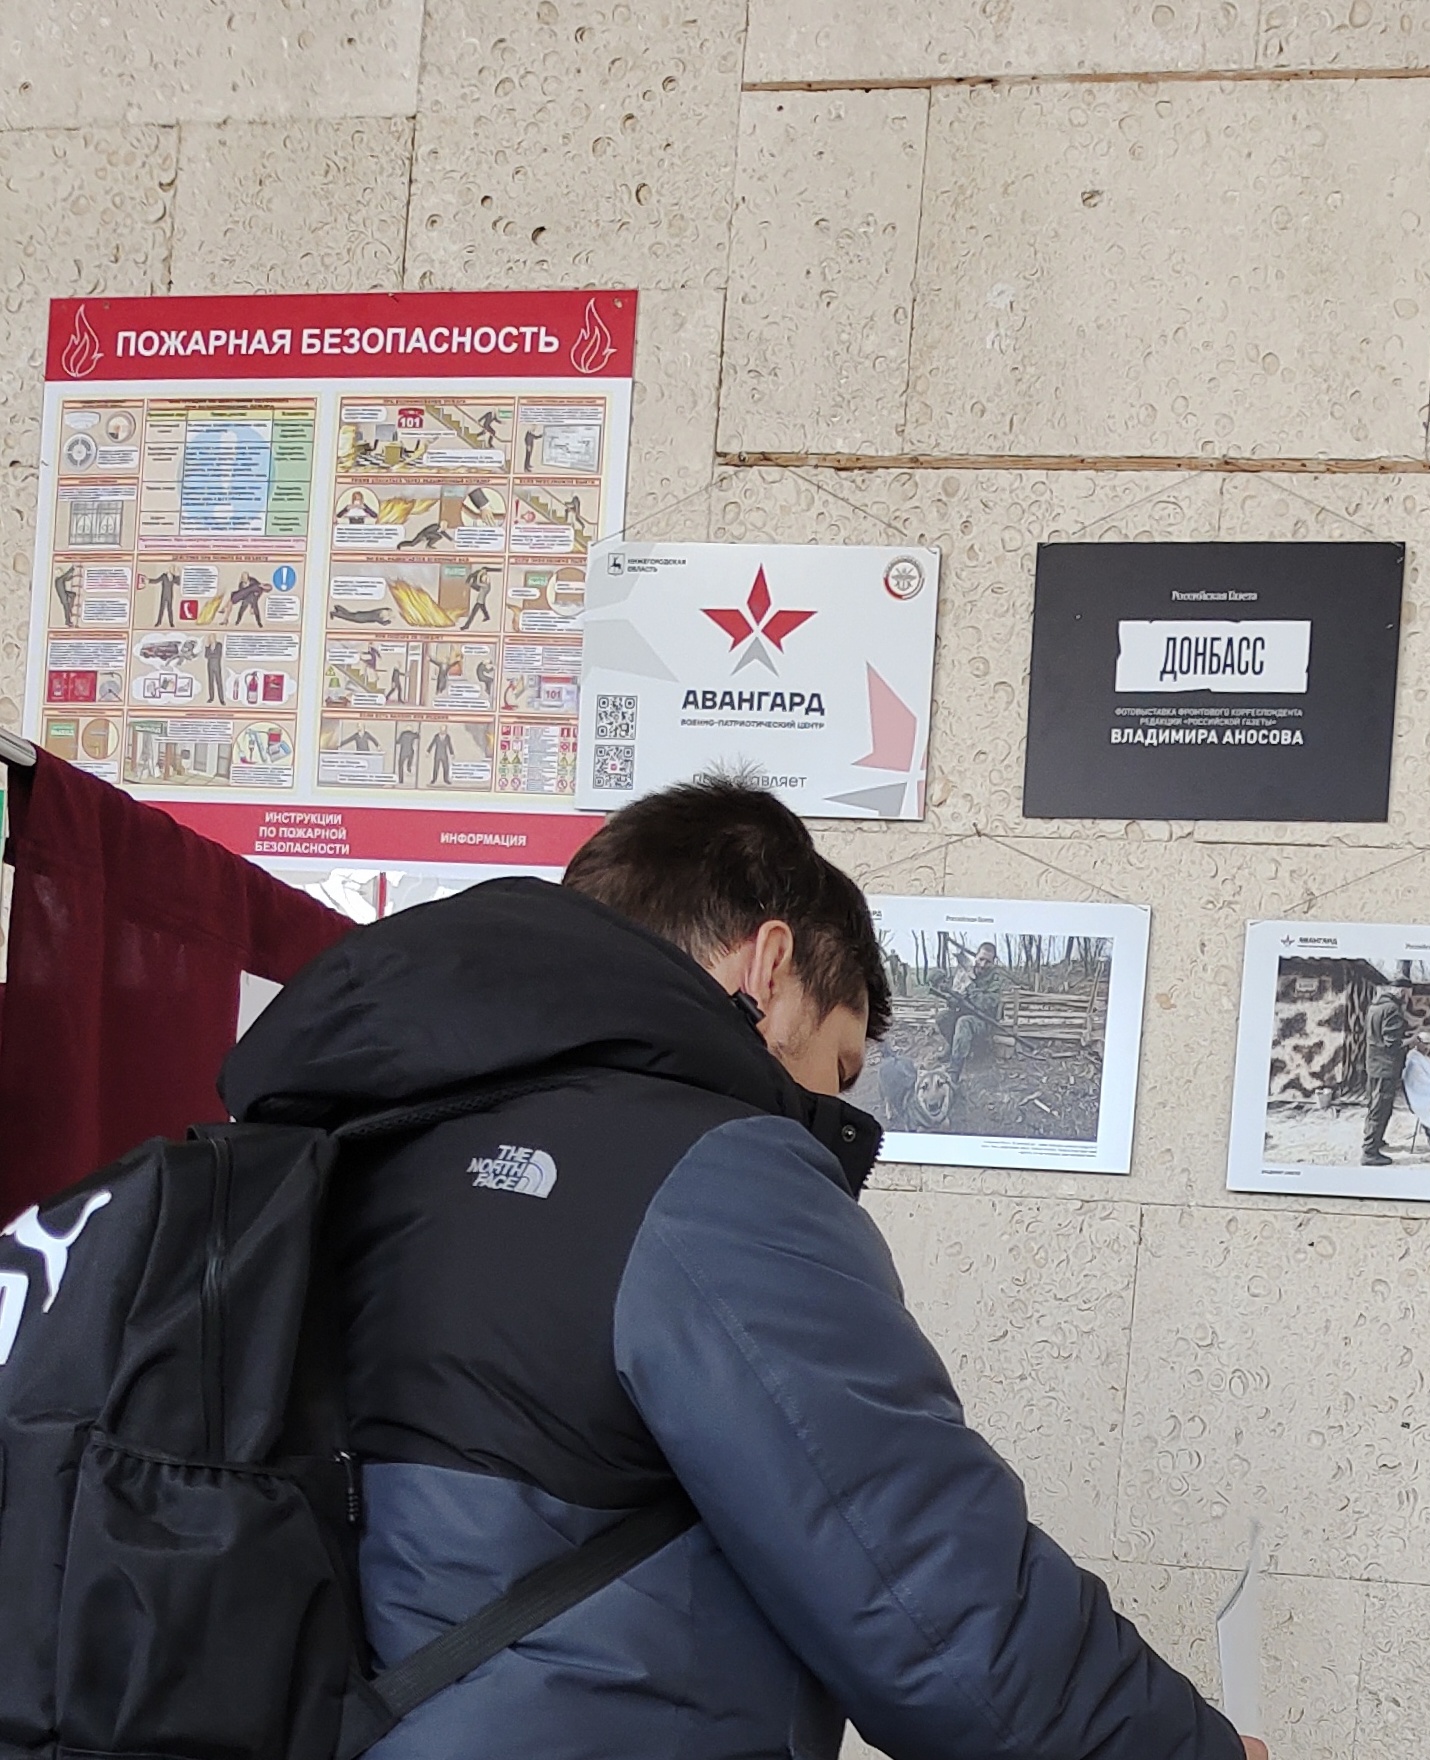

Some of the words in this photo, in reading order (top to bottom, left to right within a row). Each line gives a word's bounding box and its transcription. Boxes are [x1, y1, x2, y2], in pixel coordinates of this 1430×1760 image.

[116, 329, 291, 357] ПОЖАРНАЯ
[301, 326, 560, 354] БЕЗОПАСНОСТЬ
[399, 417, 421, 428] 101
[1159, 636, 1265, 682] ДОНБАСС
[545, 689, 562, 699] 101
[682, 689, 826, 716] АВАНГАРД
[1178, 708, 1229, 717] ФРОНТОВОГО
[681, 718, 796, 729] ВОЕННО-ПАТРИОТИЧЕСКИЙ
[797, 722, 825, 730] ЦЕНТР
[1111, 728, 1219, 746] ВЛАДИМИРА
[1222, 730, 1304, 745] АНОСОВА
[265, 811, 342, 826] ИНСТРУКЦИИ
[258, 827, 276, 838] ПО
[279, 826, 347, 840] ПОЖАРНОЙ
[440, 832, 527, 848] ИНФОРМАЦИЯ
[254, 840, 350, 855] БЕЗОПАСНОСТИ
[498, 1145, 533, 1162] THE
[466, 1158, 526, 1177] NORTH
[472, 1173, 520, 1190] FACE
